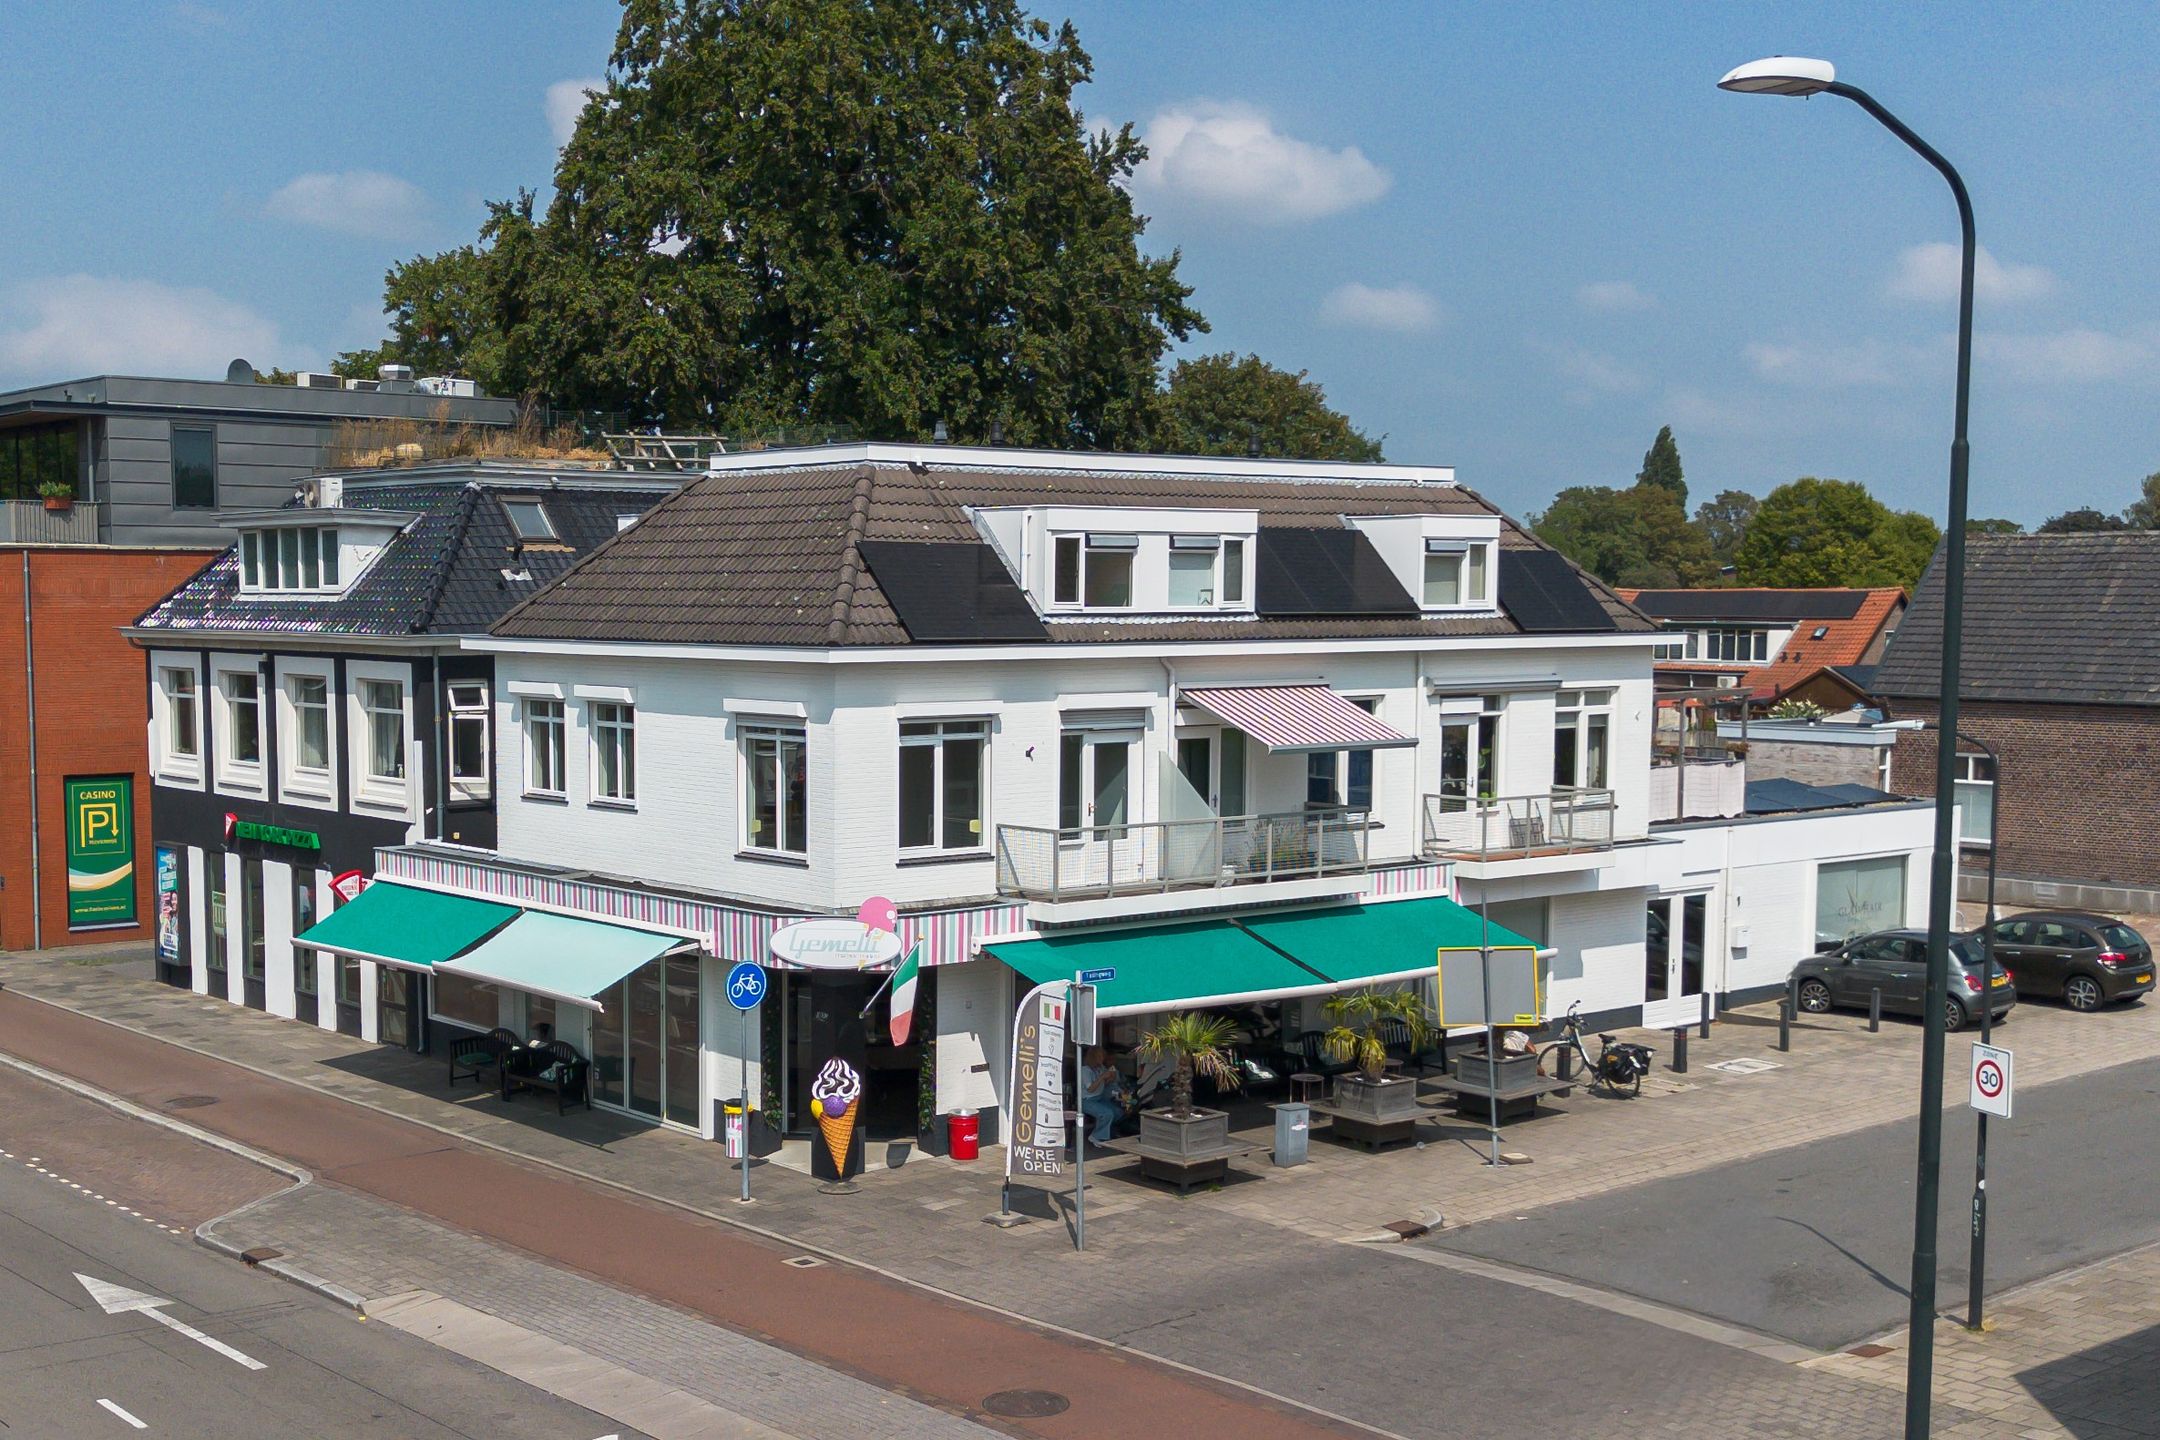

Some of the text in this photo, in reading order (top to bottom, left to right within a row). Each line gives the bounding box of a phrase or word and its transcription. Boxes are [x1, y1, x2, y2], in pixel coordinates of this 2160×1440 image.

[80, 790, 116, 800] CASINO
[789, 928, 881, 959] Gemelli
[1982, 1050, 1999, 1060] ZONE
[1016, 1025, 1036, 1143] Gemelli's
[1981, 1070, 1998, 1088] 30
[1013, 1145, 1056, 1161] WE'RE
